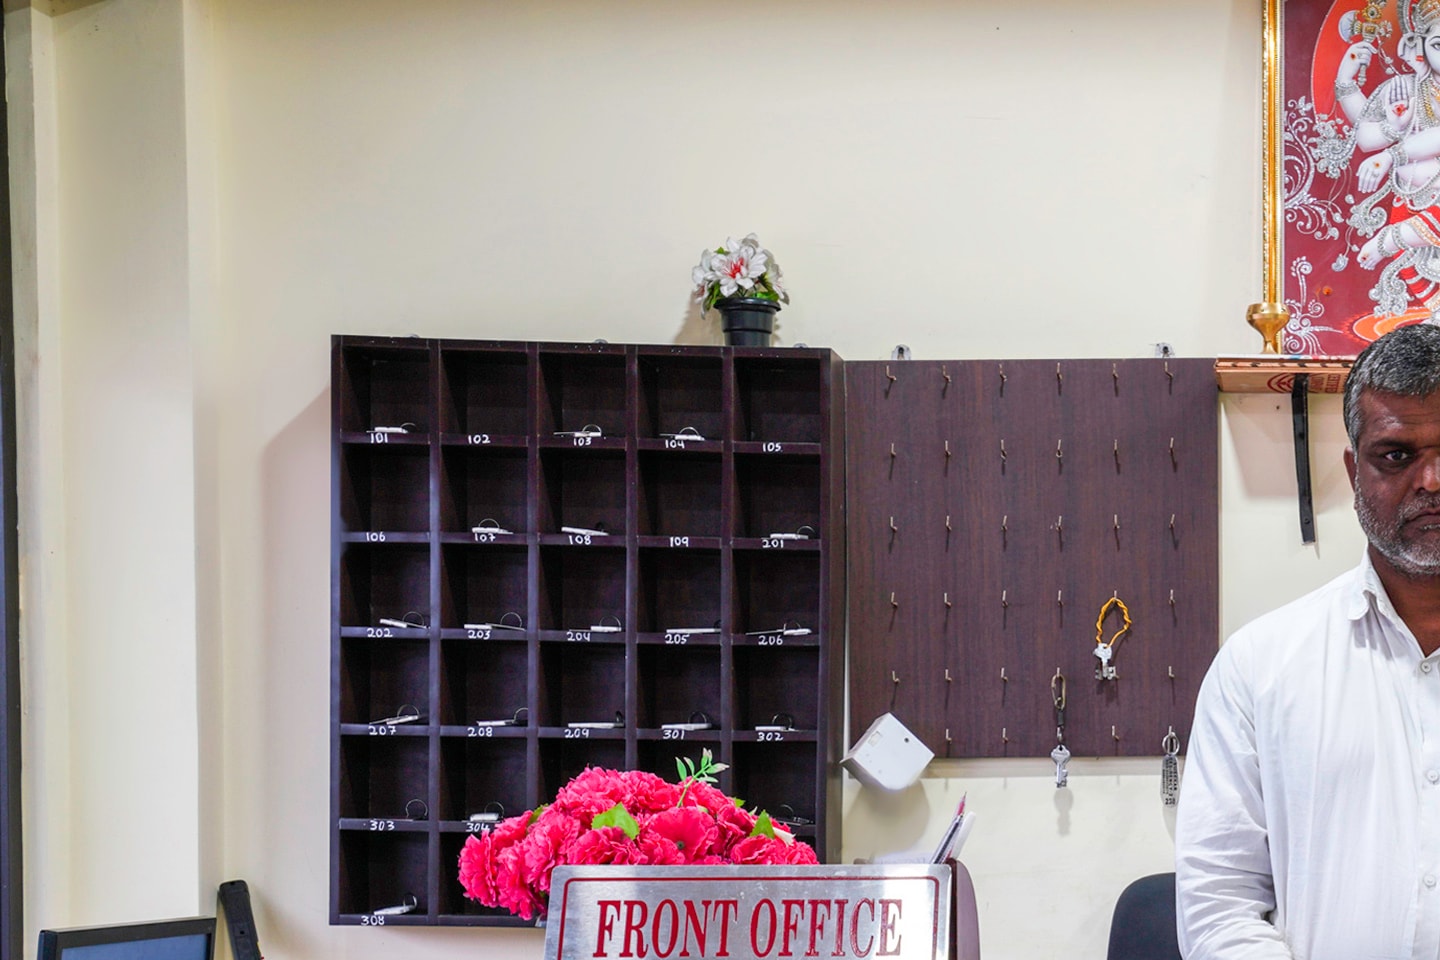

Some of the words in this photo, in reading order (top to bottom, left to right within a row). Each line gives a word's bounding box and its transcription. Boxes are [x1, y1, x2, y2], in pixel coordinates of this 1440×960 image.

[370, 433, 388, 443] 101
[468, 435, 490, 444] 102
[573, 437, 591, 446] 103
[665, 439, 684, 449] 104
[763, 442, 781, 452] 105
[366, 532, 385, 541] 106
[475, 533, 495, 542] 107
[569, 535, 591, 545] 108
[670, 537, 688, 547] 109
[762, 539, 784, 548] 201
[367, 628, 393, 637] 202
[468, 630, 490, 639] 203
[567, 632, 590, 642] 204
[665, 634, 689, 644] 205
[759, 636, 782, 645] 206
[369, 726, 396, 735] 207
[468, 727, 492, 736] 208
[565, 728, 589, 738] 209
[663, 730, 684, 739] 301
[757, 731, 783, 741] 302
[370, 820, 394, 831] 303
[593, 898, 738, 958] FRONT
[750, 897, 903, 958] OFFICE
